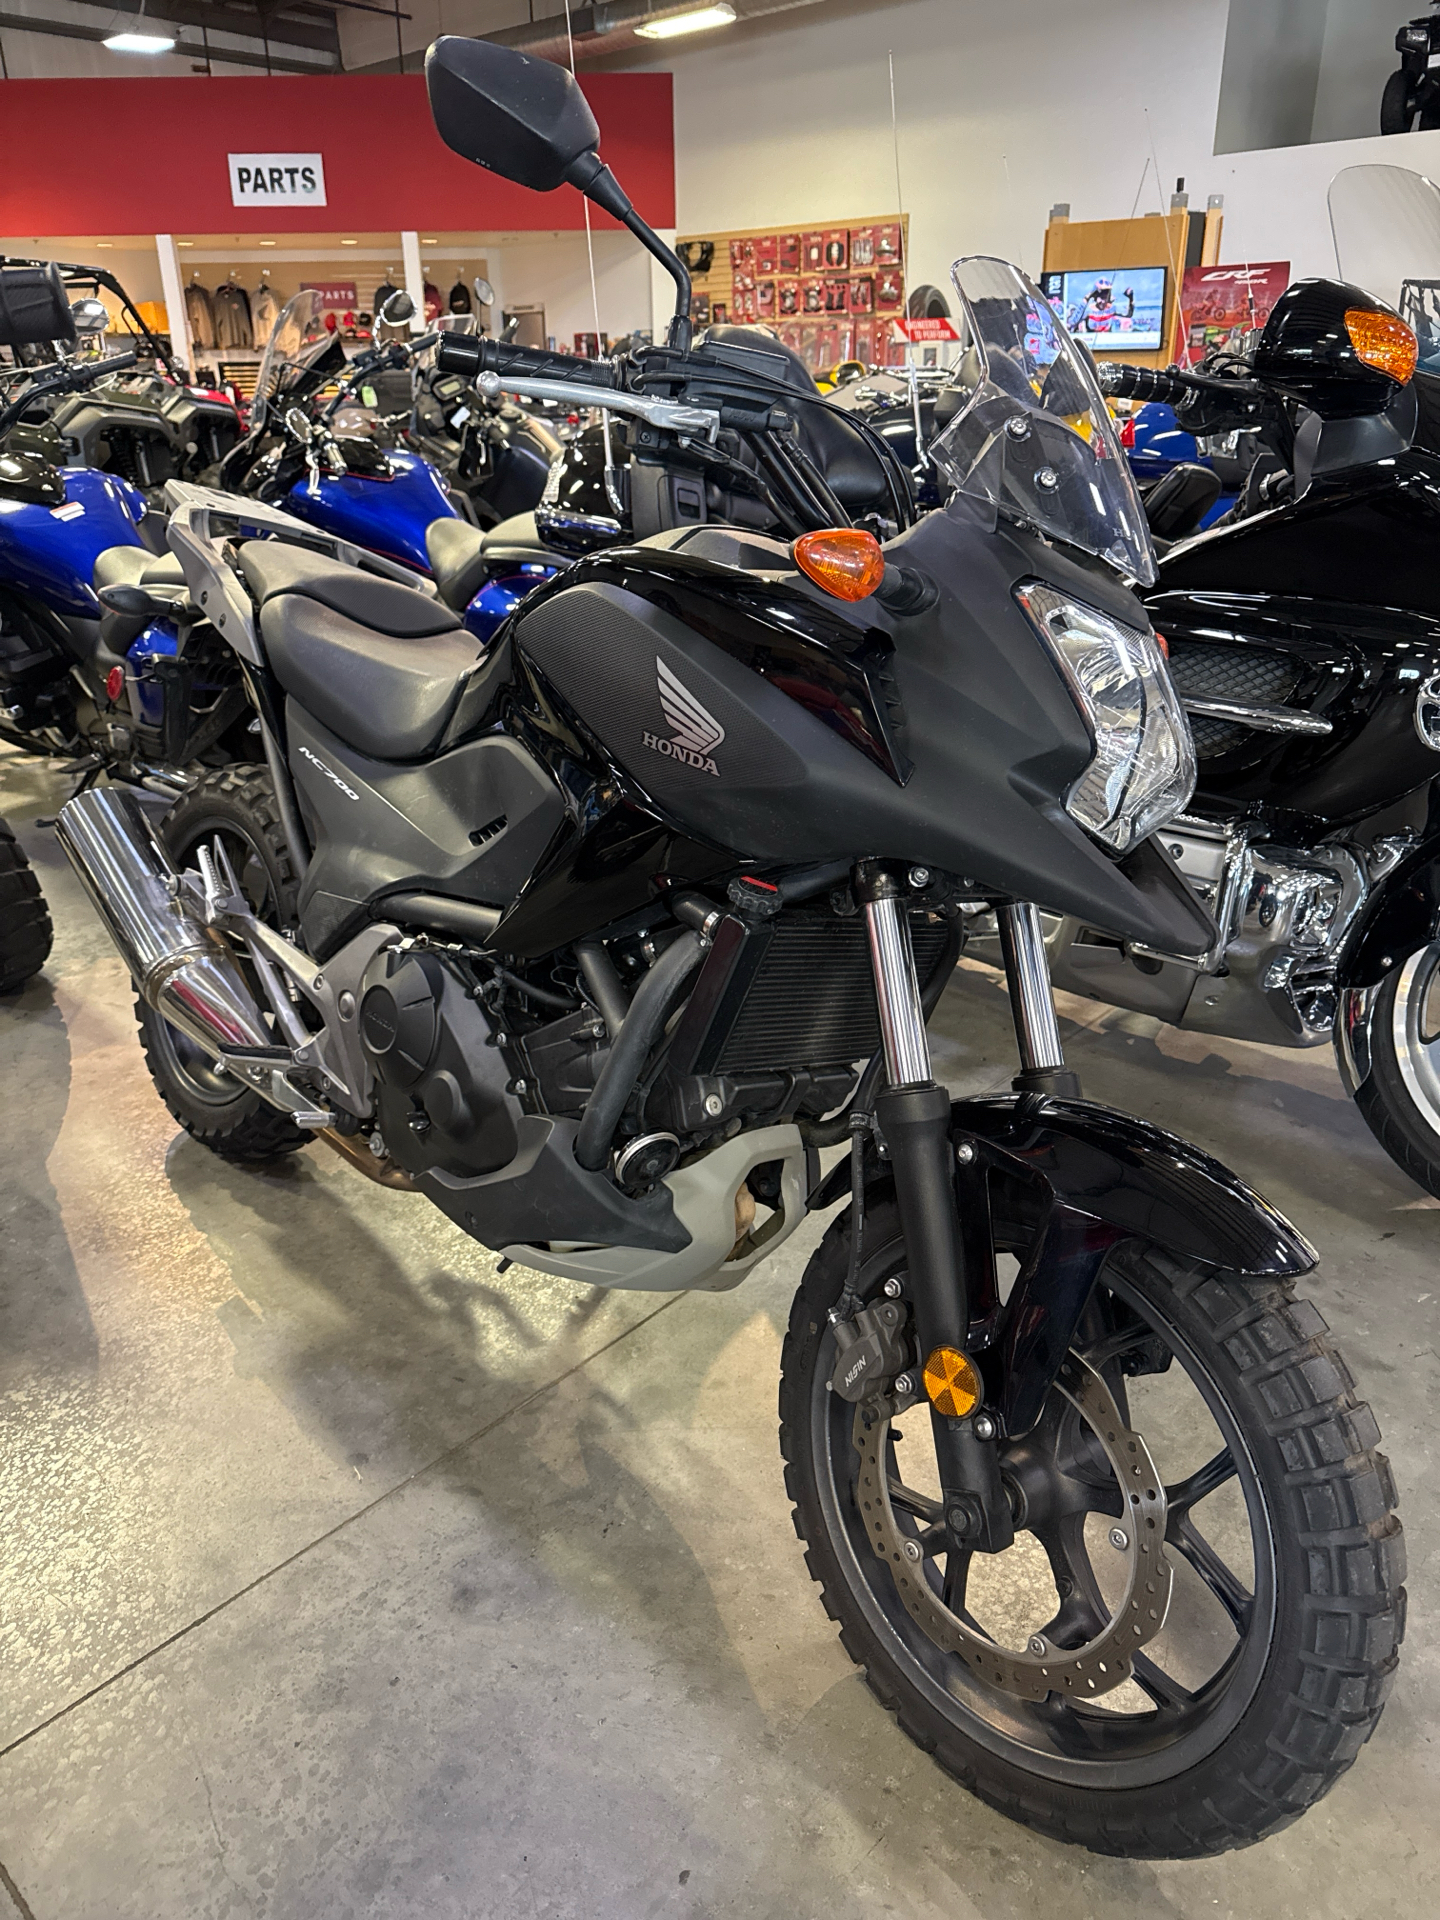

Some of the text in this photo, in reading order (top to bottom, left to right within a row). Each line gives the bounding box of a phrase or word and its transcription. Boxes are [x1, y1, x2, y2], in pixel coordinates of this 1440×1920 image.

[237, 167, 316, 194] PARTS
[1201, 268, 1271, 281] CRF
[319, 290, 354, 300] PARTS
[914, 330, 922, 340] TO
[923, 330, 951, 339] PERFORM
[642, 731, 721, 777] HONDA
[298, 746, 360, 801] NC700
